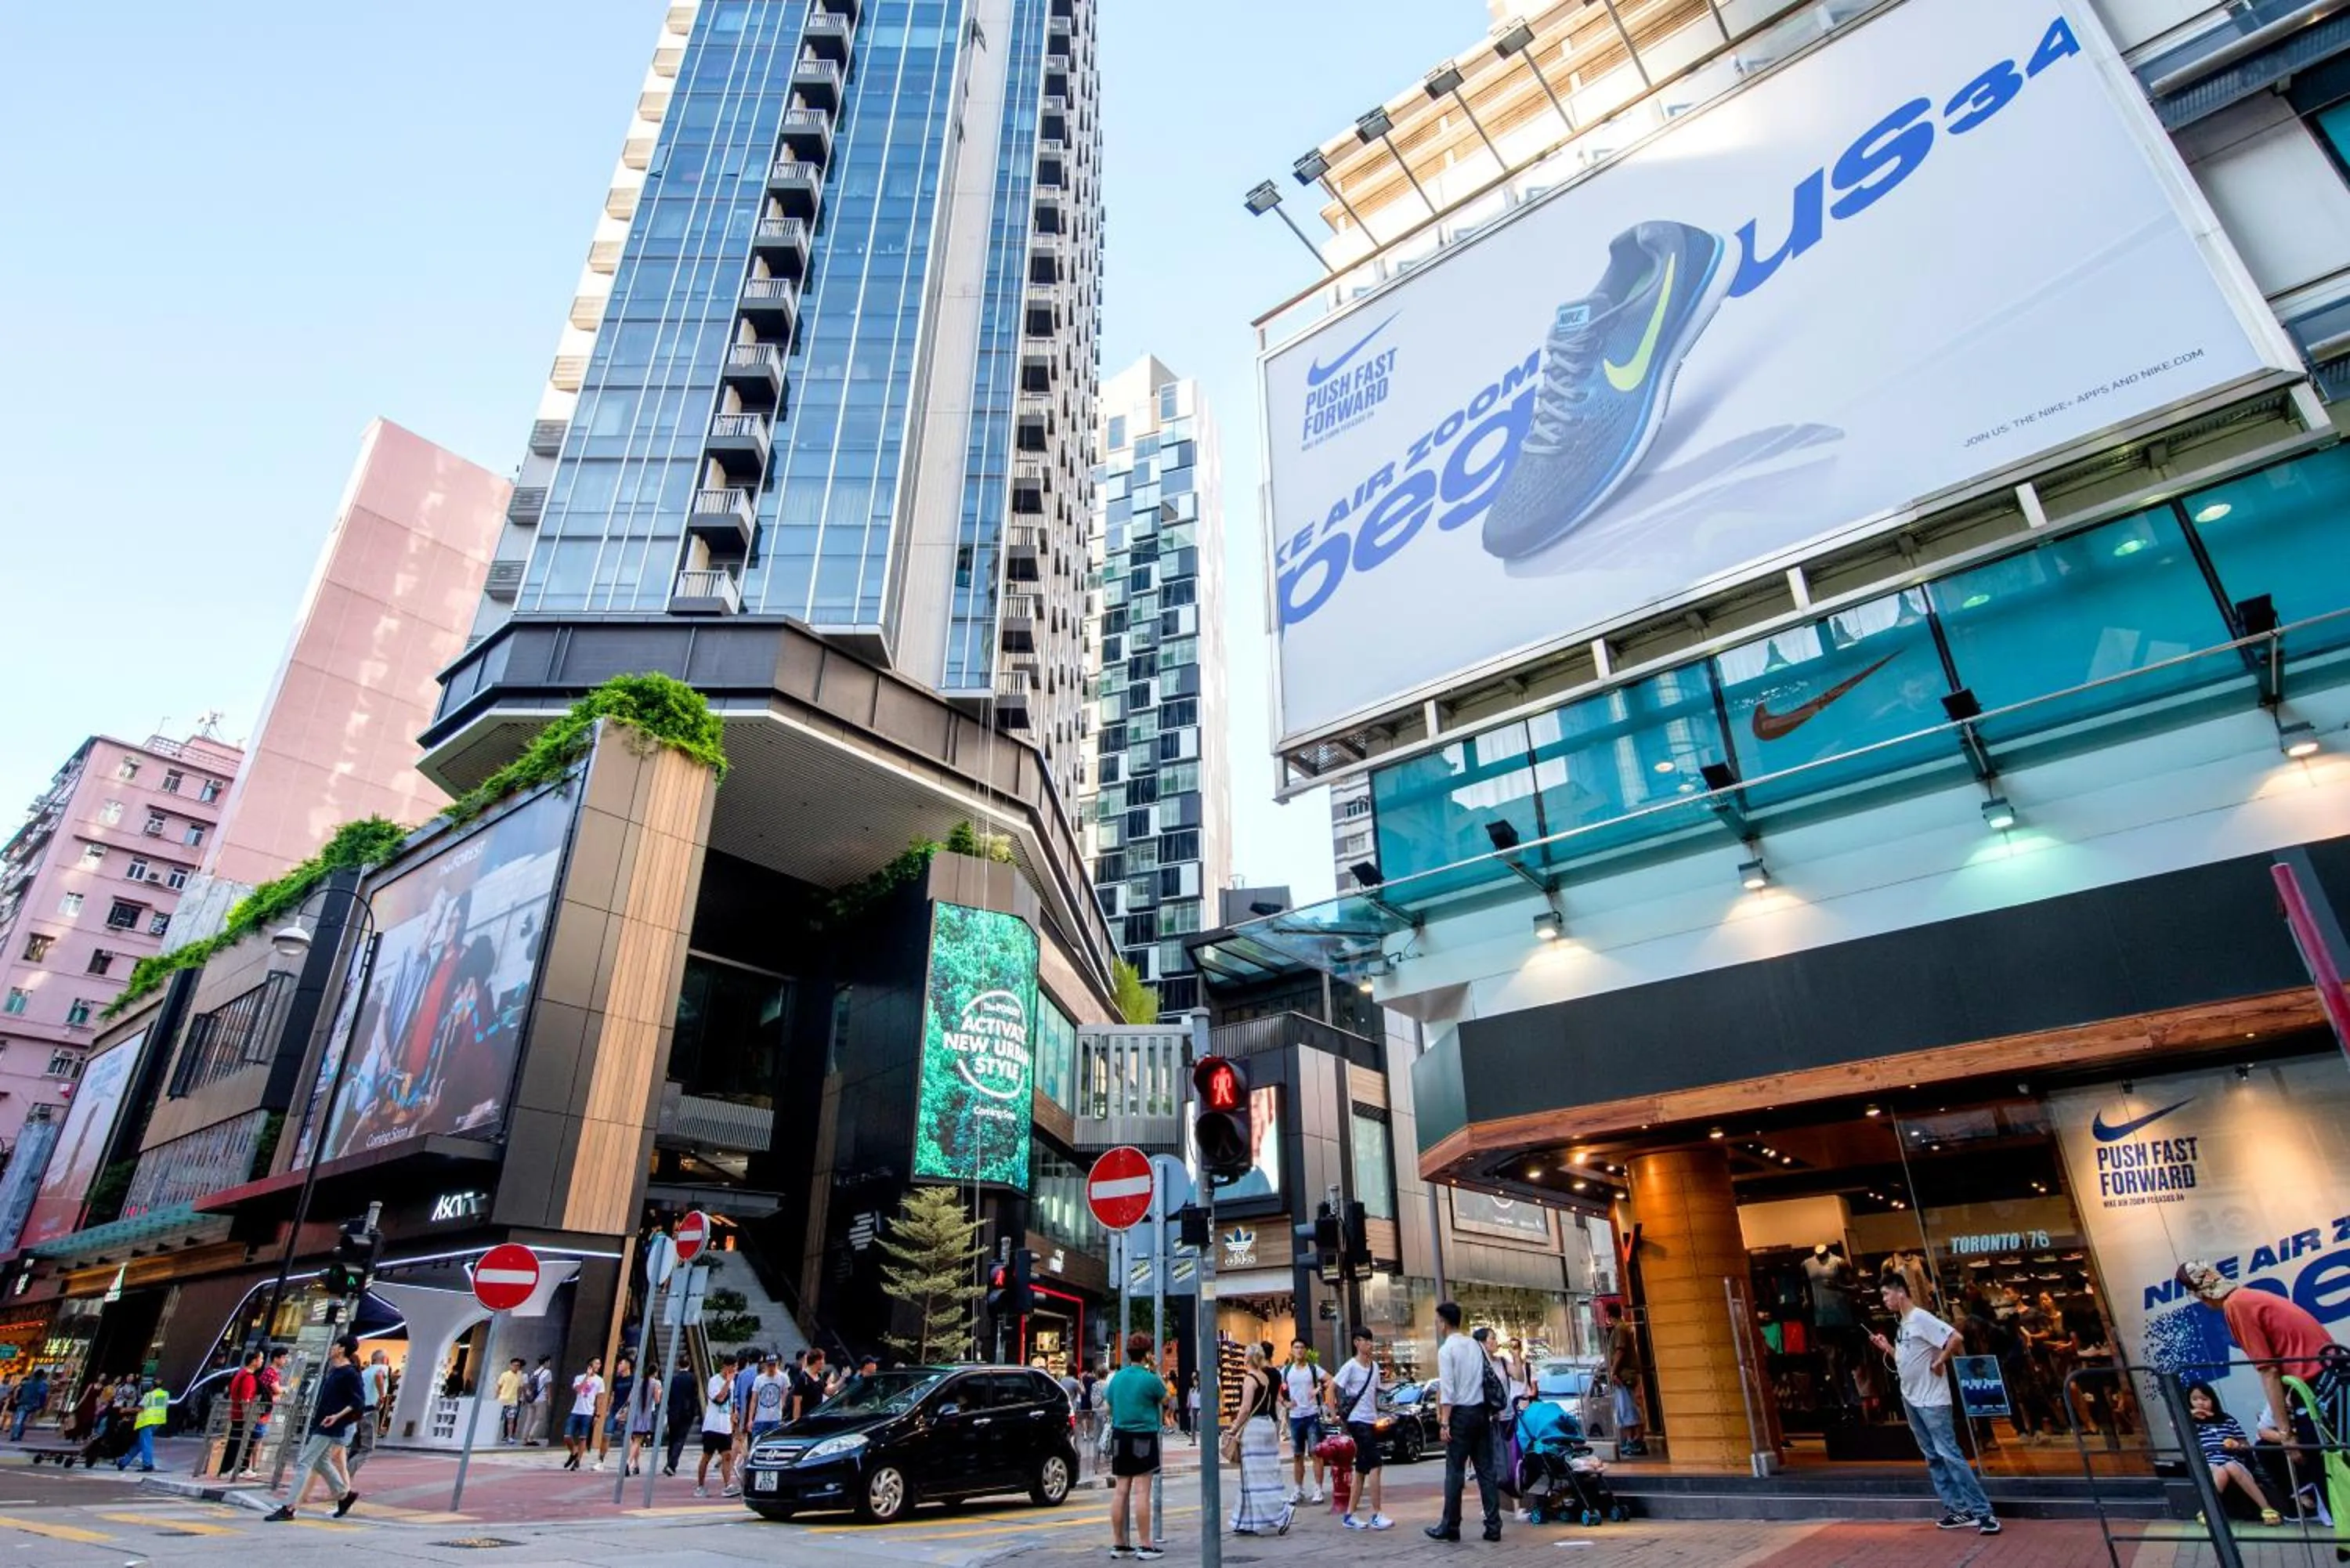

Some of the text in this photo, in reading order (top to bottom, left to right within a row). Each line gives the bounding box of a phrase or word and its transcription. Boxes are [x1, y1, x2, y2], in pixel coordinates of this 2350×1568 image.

[1305, 347, 1398, 416] PUSH FAST
[1303, 377, 1390, 441] FORWARD
[1963, 432, 1990, 447] JOIN
[2012, 414, 2036, 428] THE
[2077, 385, 2110, 403] APPS
[2113, 374, 2138, 391] AND
[1321, 461, 1396, 536] AIR
[1405, 349, 1541, 471] ZOOM
[943, 1031, 990, 1053] NEW
[974, 1056, 1019, 1082] STYLE
[2096, 1136, 2198, 1171] PUSH FAST
[2099, 1164, 2197, 1197] FORWARD
[1950, 1229, 2051, 1254] TORONTO 76
[2144, 1255, 2239, 1310] NIE
[2247, 1227, 2322, 1274] AIR
